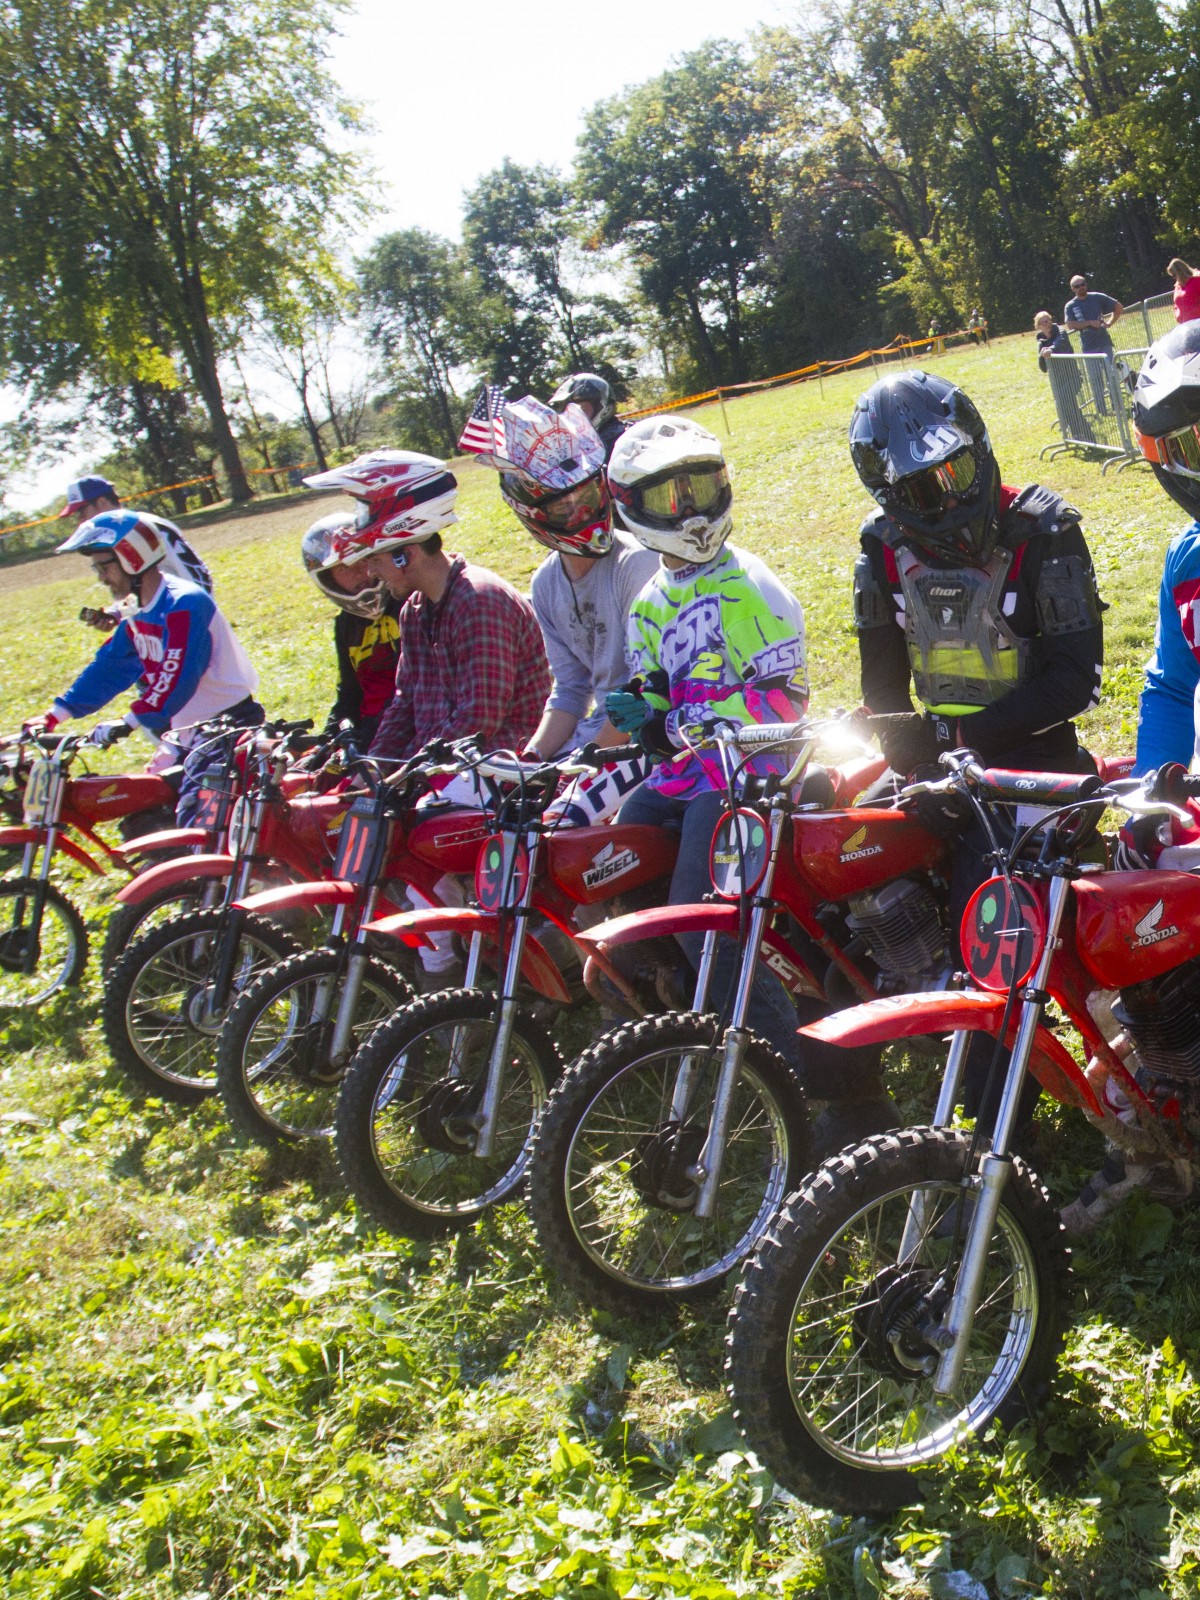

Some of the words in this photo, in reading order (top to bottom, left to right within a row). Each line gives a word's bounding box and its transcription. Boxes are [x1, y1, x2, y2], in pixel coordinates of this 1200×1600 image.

[929, 587, 962, 597] thor
[144, 648, 183, 708] HONDA
[690, 651, 724, 681] 2
[739, 728, 787, 742] RENTHAL
[840, 845, 883, 863] HONDA
[971, 876, 1036, 988] 95
